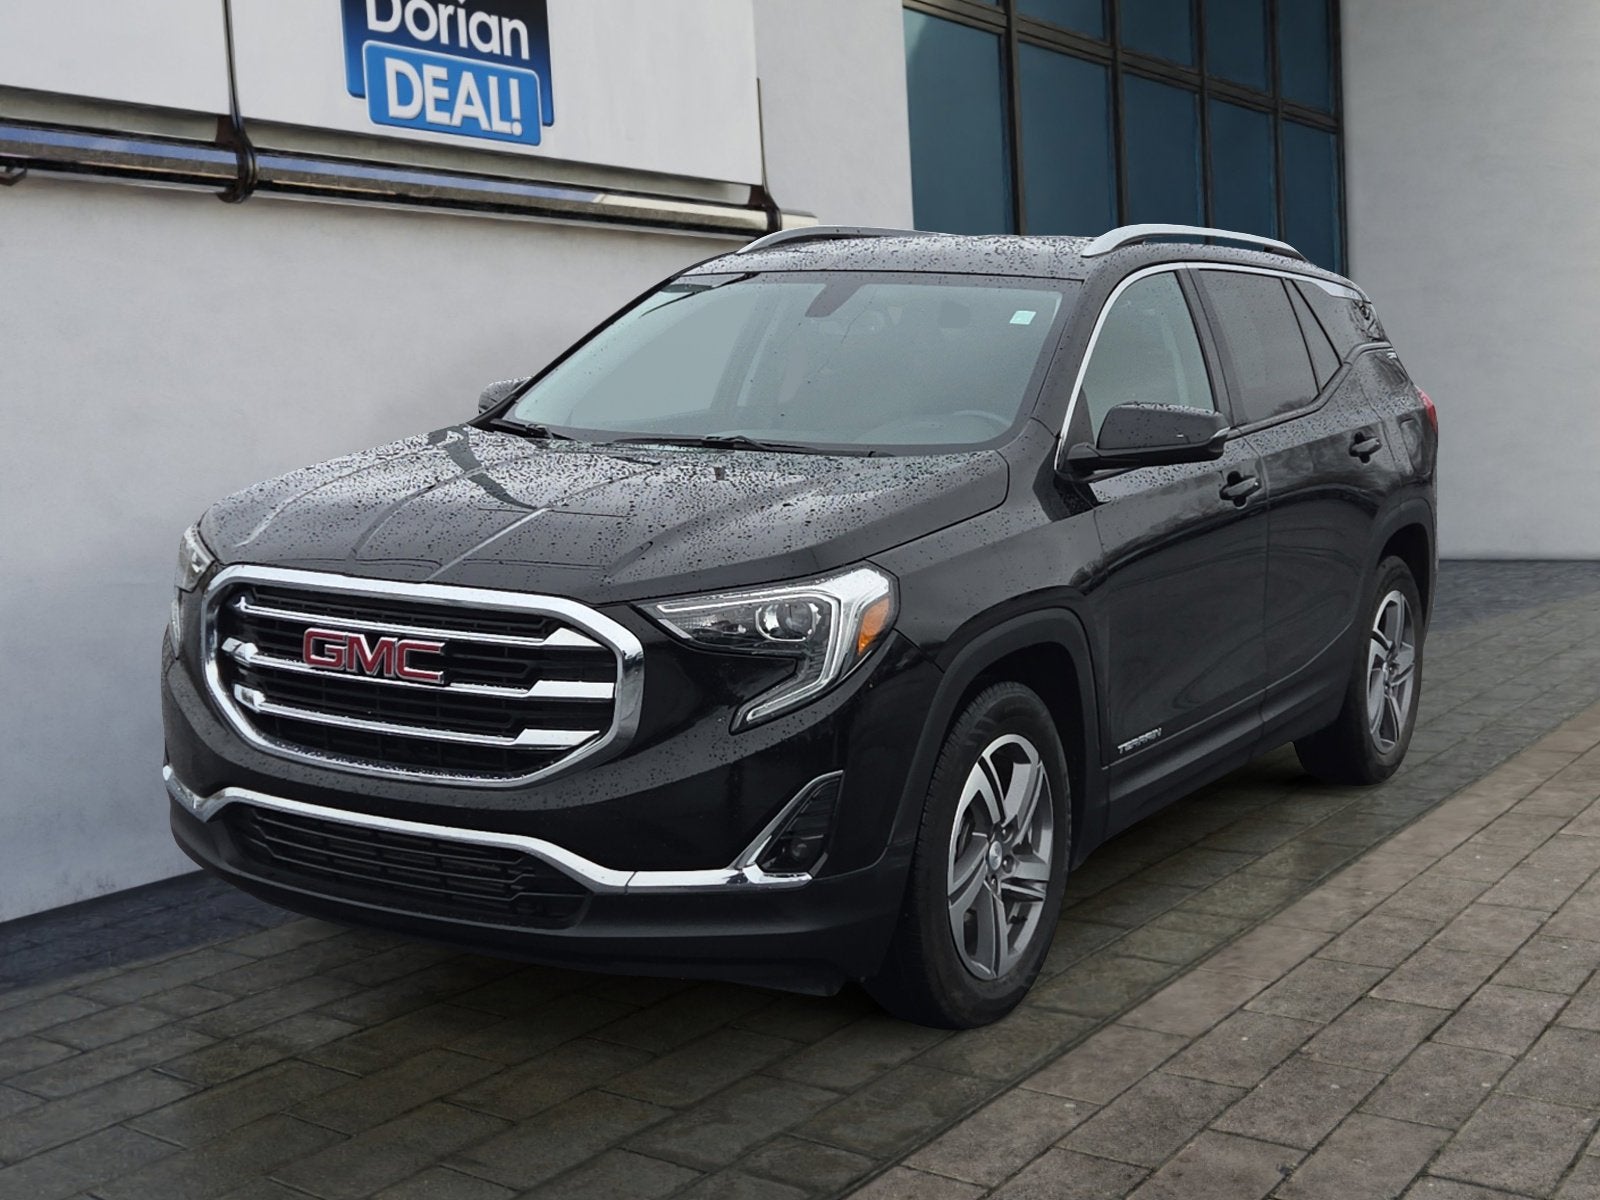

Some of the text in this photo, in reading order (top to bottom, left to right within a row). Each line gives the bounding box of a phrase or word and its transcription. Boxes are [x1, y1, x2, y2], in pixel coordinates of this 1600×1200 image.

[365, 0, 530, 60] Dorian
[384, 57, 523, 137] DEAL!
[303, 628, 445, 684] GMC
